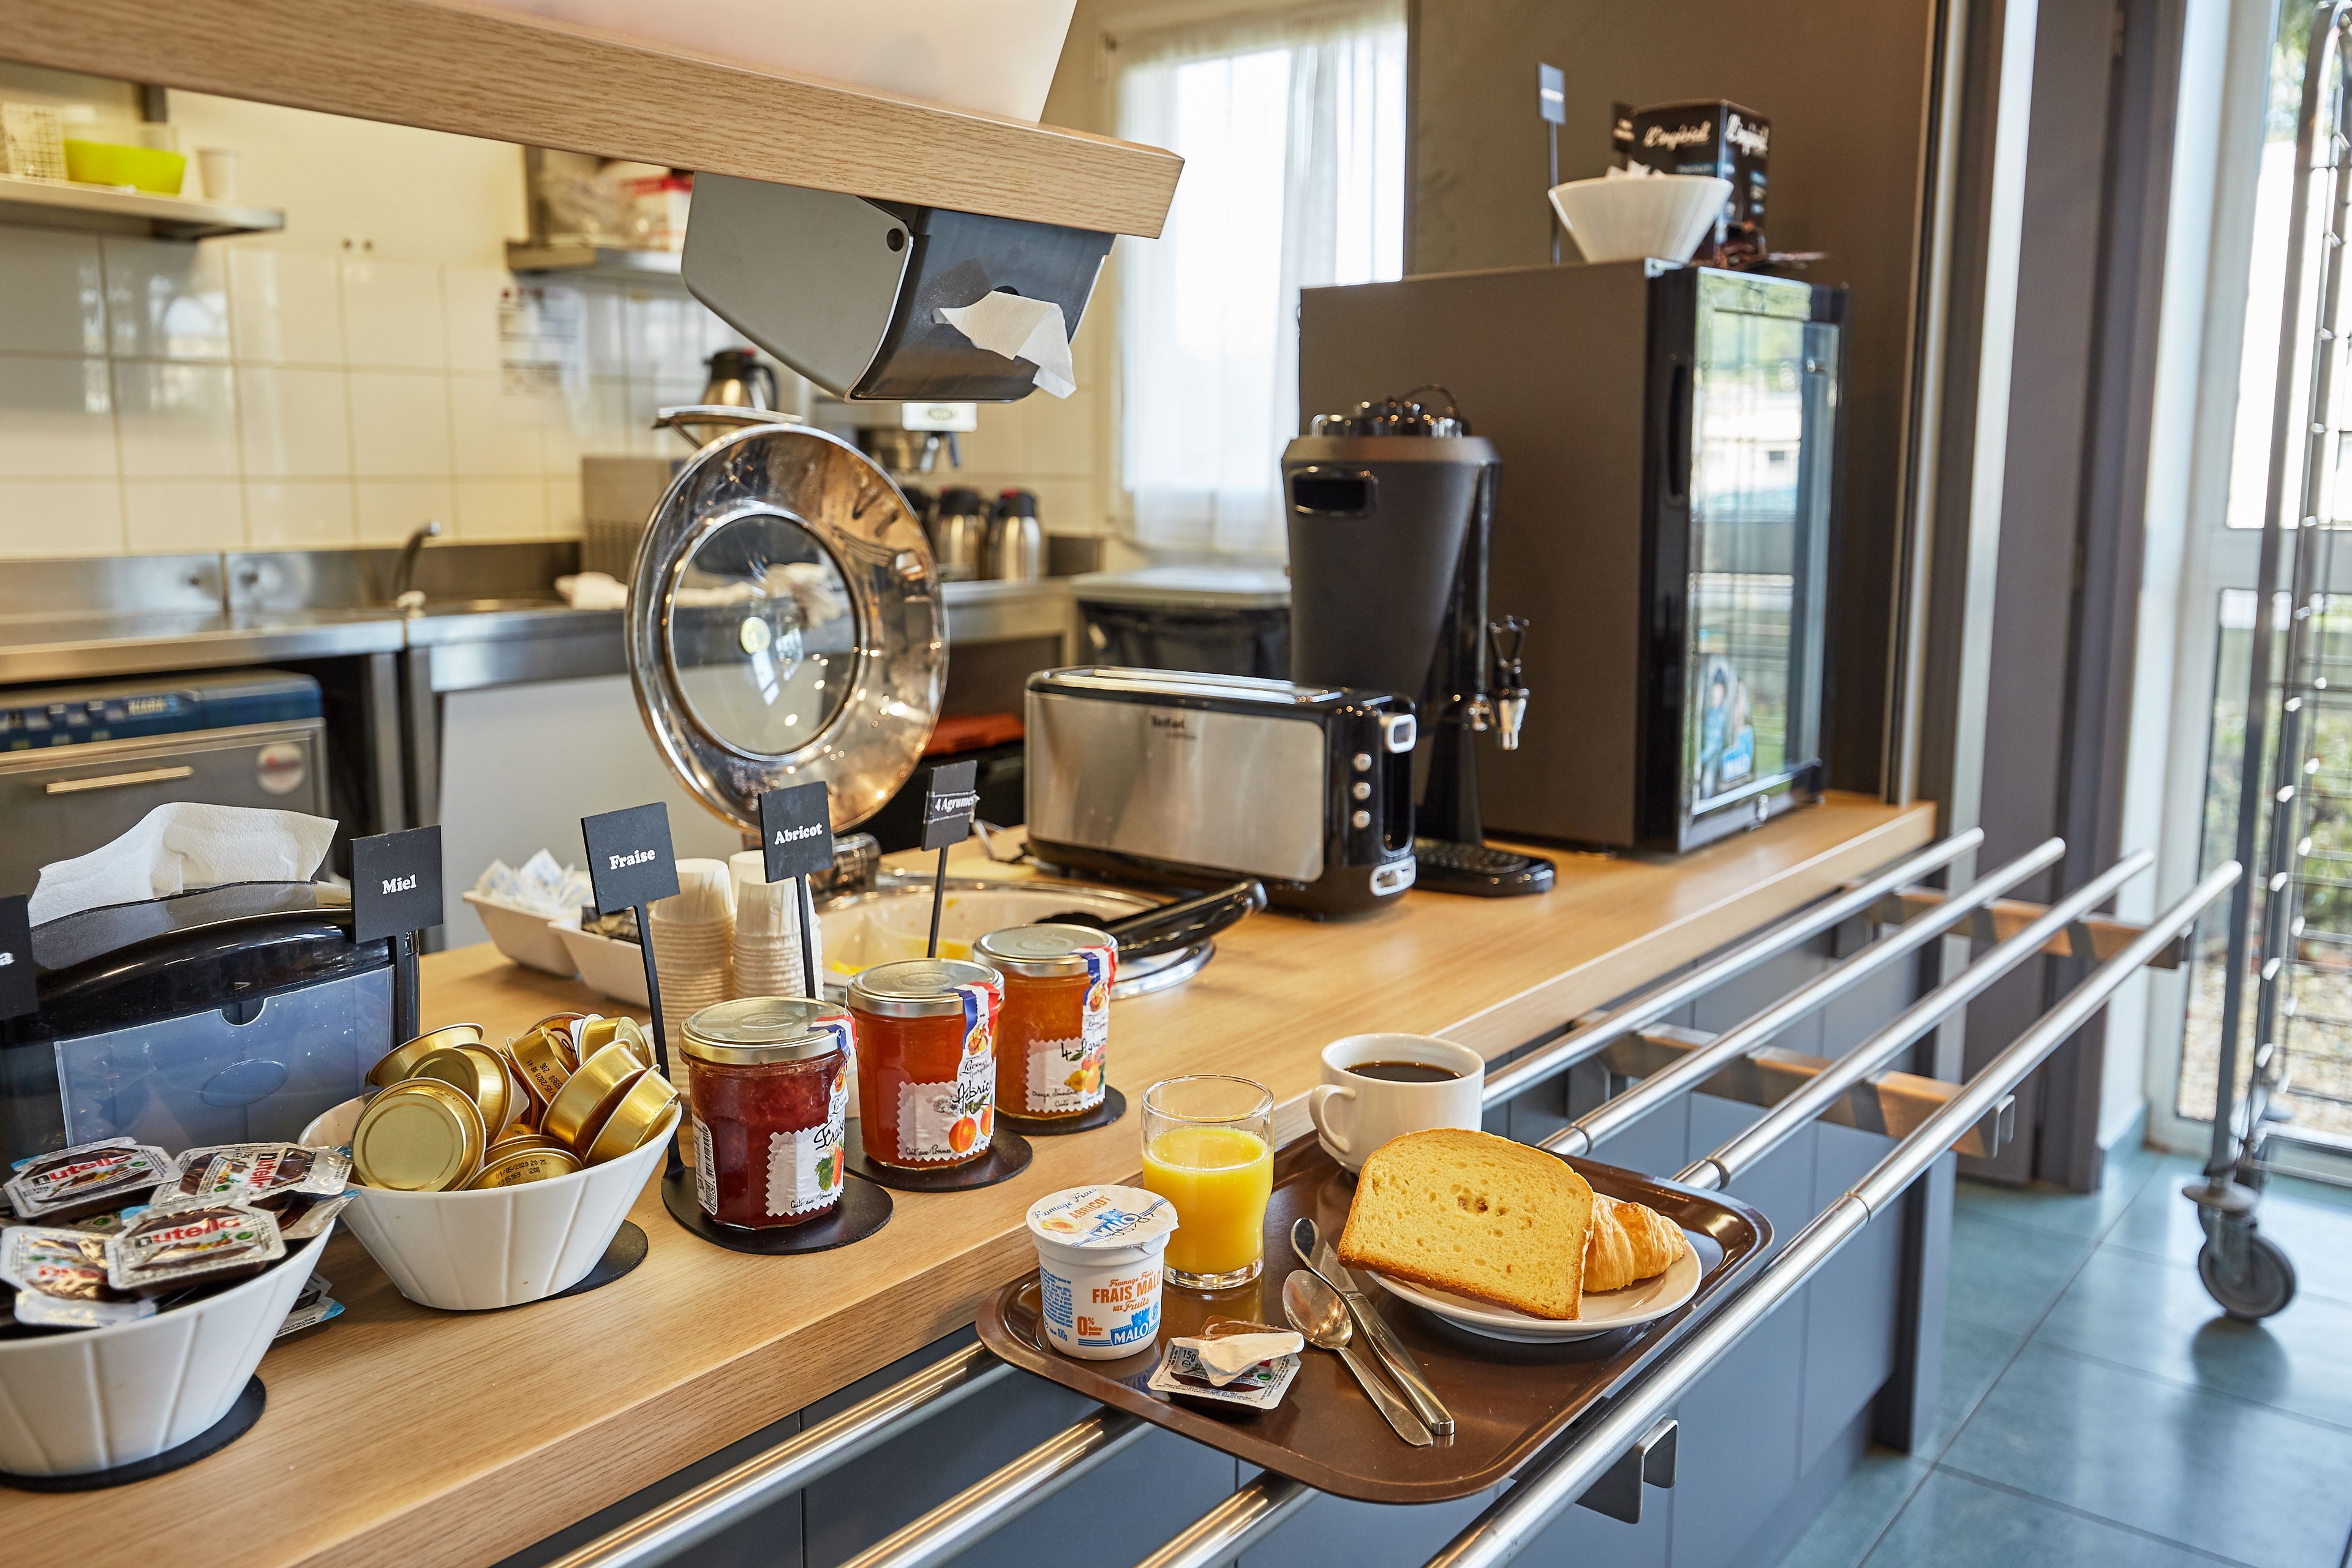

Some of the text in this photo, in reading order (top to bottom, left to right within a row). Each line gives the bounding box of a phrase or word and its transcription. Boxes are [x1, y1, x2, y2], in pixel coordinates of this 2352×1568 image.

[774, 822, 823, 846] Abricot
[608, 847, 656, 871] Fraise
[382, 873, 417, 895] Miel
[952, 1080, 992, 1115] Abric
[31, 1155, 132, 1187] nutella
[1031, 1201, 1073, 1219] Fromage
[1068, 1195, 1113, 1220] ABRICOT
[135, 1216, 241, 1248] nutella
[1092, 1269, 1161, 1304] FRAIS MALO
[1109, 1269, 1154, 1287] Fromage Frais
[1123, 1297, 1150, 1313] Fruits
[1114, 1322, 1149, 1345] MALO
[1182, 1349, 1197, 1362] 15g
